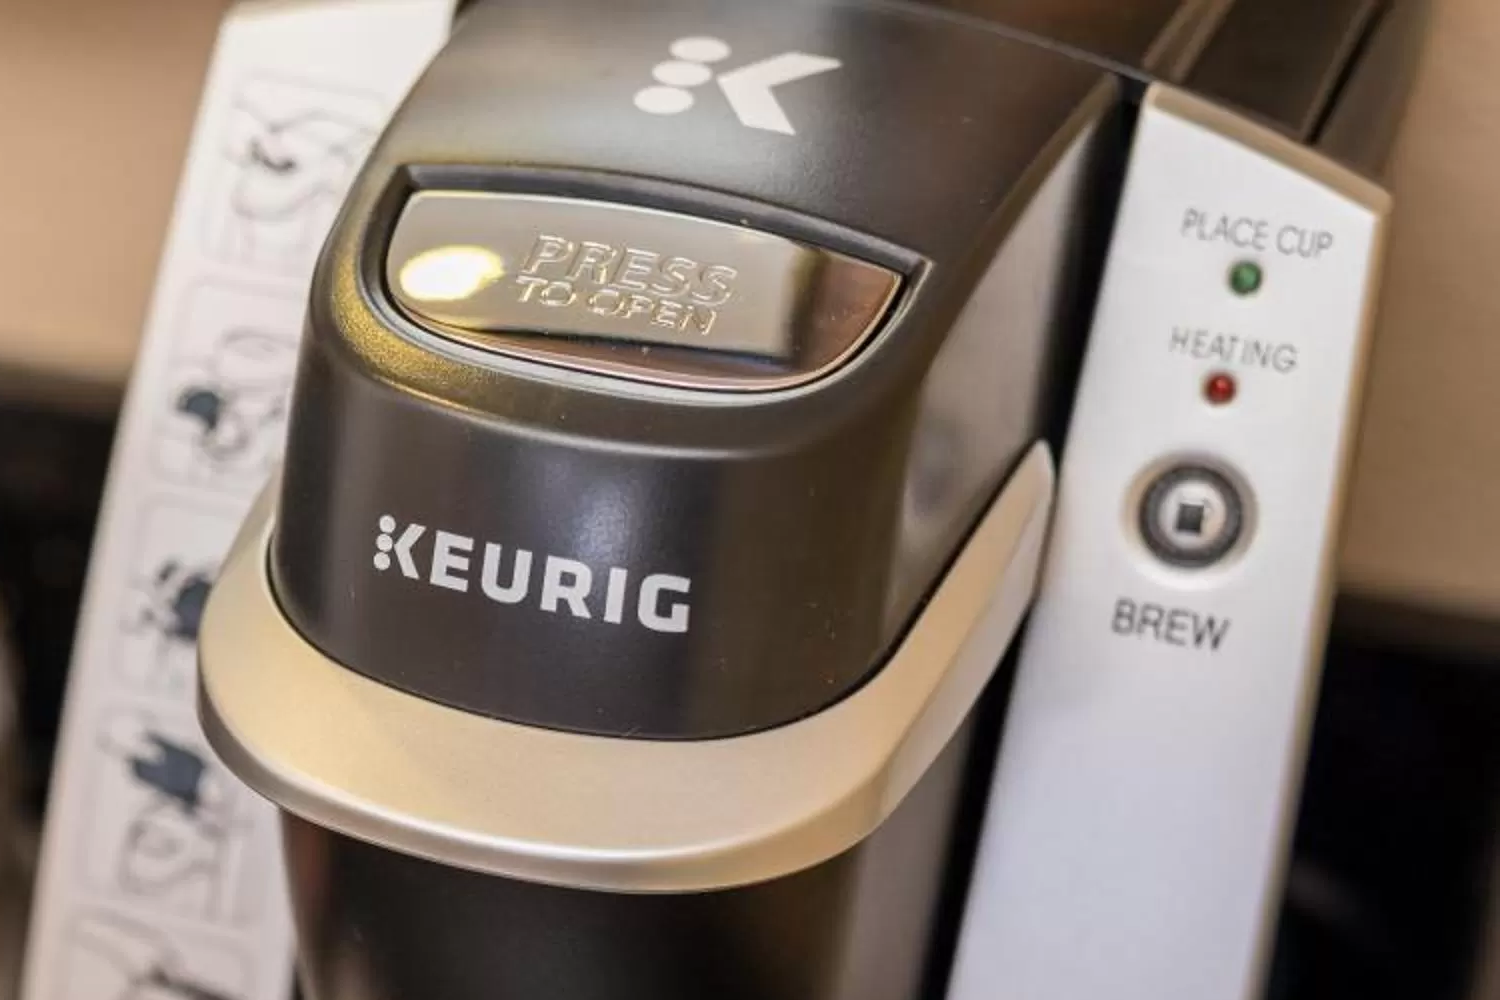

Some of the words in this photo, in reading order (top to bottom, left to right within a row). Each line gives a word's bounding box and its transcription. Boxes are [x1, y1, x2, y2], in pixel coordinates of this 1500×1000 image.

[1180, 208, 1270, 252] PLACE
[1275, 223, 1334, 259] CUP
[520, 234, 739, 307] PRESS
[514, 275, 577, 308] TO
[588, 289, 718, 336] OPEN
[1169, 327, 1298, 373] HEATING
[373, 514, 691, 633] KEURIG
[1110, 597, 1230, 650] BREW
